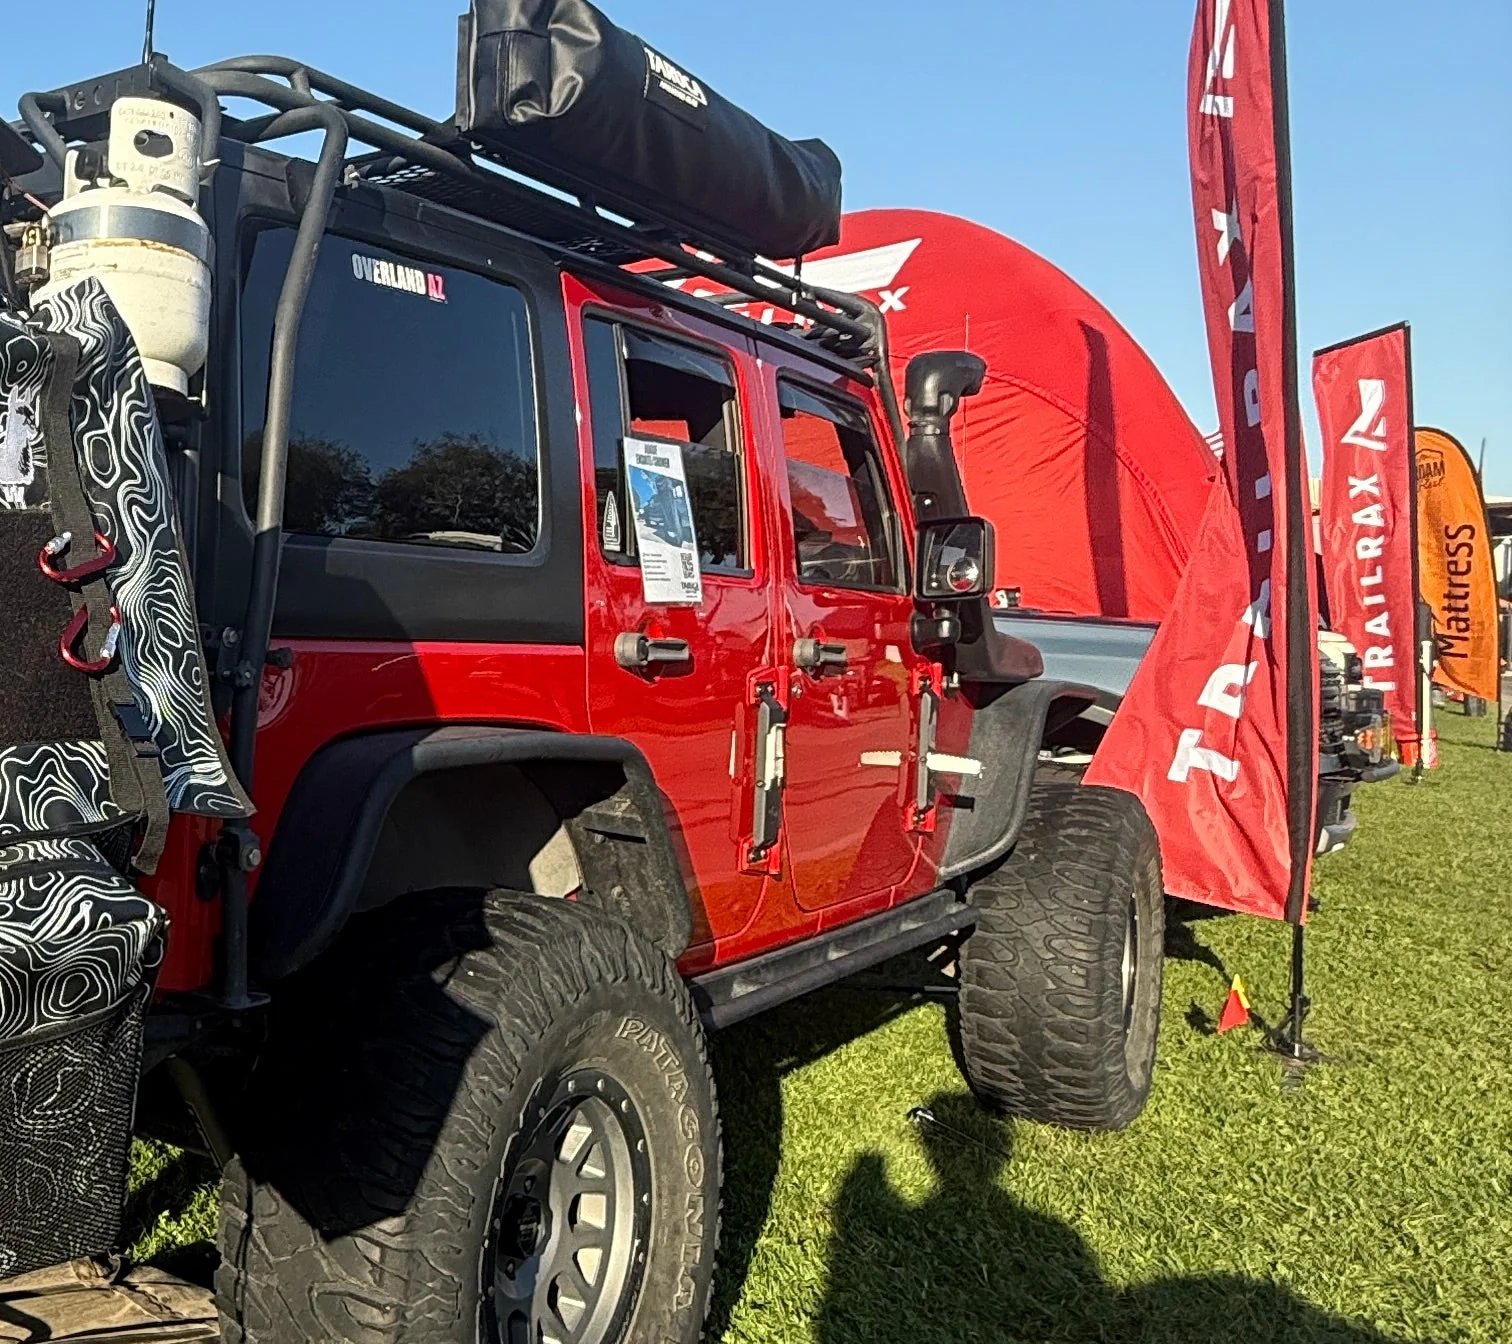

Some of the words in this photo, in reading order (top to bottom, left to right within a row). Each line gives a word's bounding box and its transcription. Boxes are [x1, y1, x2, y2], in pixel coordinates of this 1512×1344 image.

[352, 254, 426, 295] OVERLAND
[1348, 473, 1395, 692] TRAILRAX
[1437, 524, 1476, 659] Mattress
[615, 1016, 705, 1312] PATAGONIA
